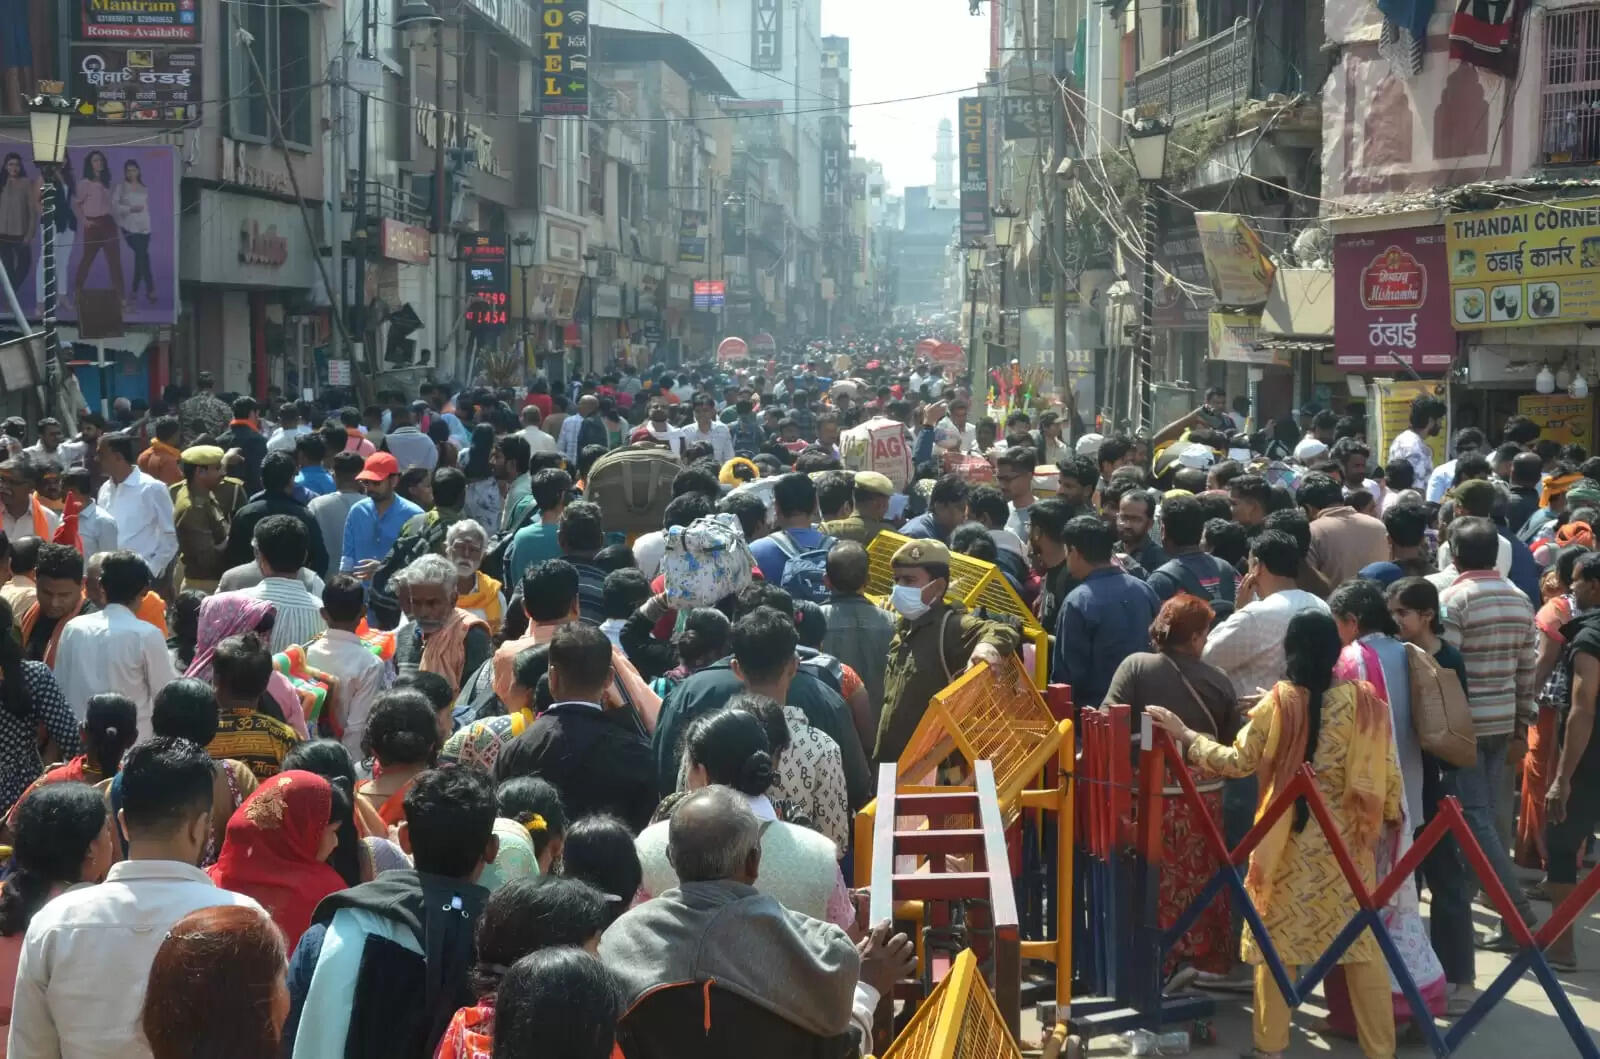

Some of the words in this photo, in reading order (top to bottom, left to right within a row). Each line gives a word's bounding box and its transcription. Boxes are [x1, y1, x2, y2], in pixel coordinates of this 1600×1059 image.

[91, 0, 177, 12] Mantram
[88, 26, 130, 36] Rooms
[134, 27, 190, 38] Available
[543, 0, 563, 95] OTEL
[964, 103, 982, 168] HOTEL
[1453, 214, 1528, 239] THANDAI
[1534, 206, 1600, 232] CORNE
[1485, 240, 1527, 275] ठंडाई
[1368, 284, 1419, 301] Mishrambu
[1368, 313, 1417, 349] ठंडाई
[801, 766, 812, 789] BG
